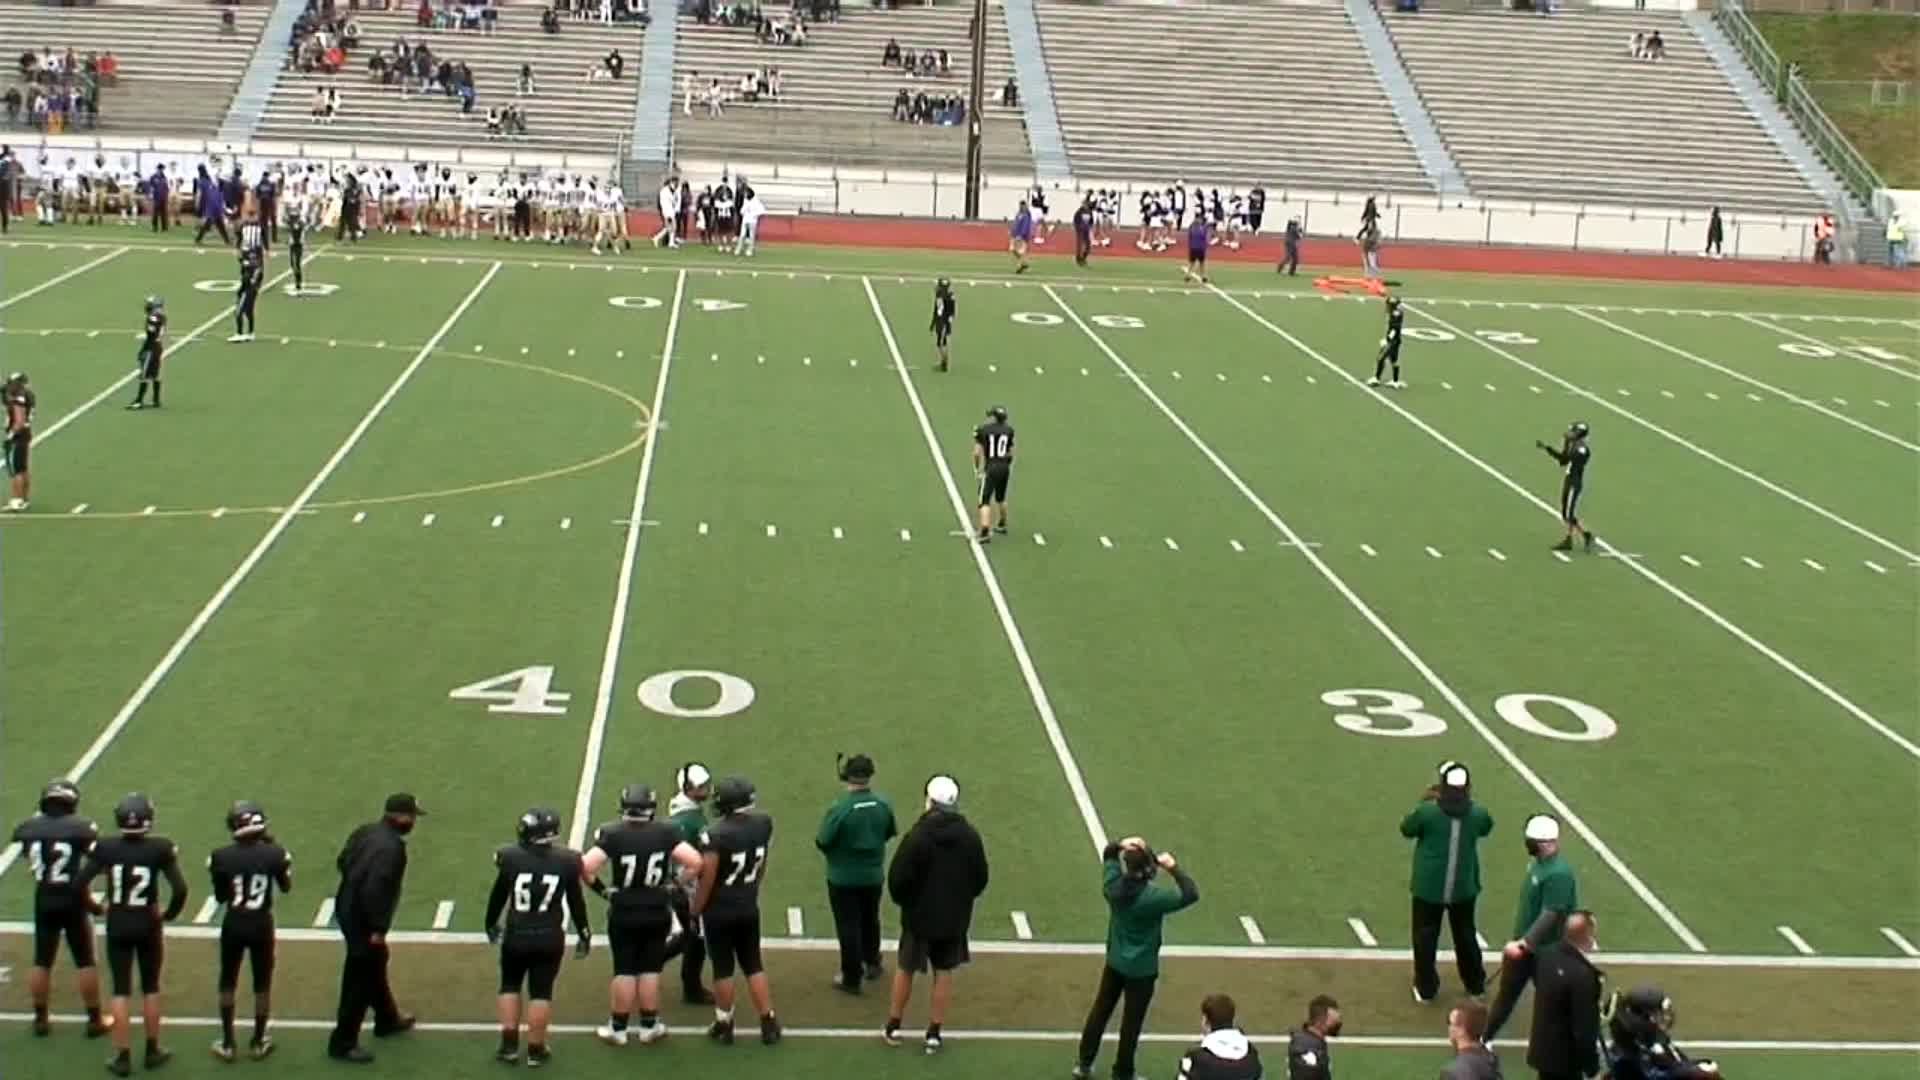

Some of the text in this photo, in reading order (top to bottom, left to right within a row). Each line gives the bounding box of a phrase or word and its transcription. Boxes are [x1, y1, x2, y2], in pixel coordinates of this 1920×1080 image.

[989, 434, 1009, 457] 10
[29, 839, 73, 883] 42
[620, 852, 665, 888] 76
[112, 864, 151, 906] 12
[232, 874, 269, 910] 19
[514, 873, 560, 912] 67
